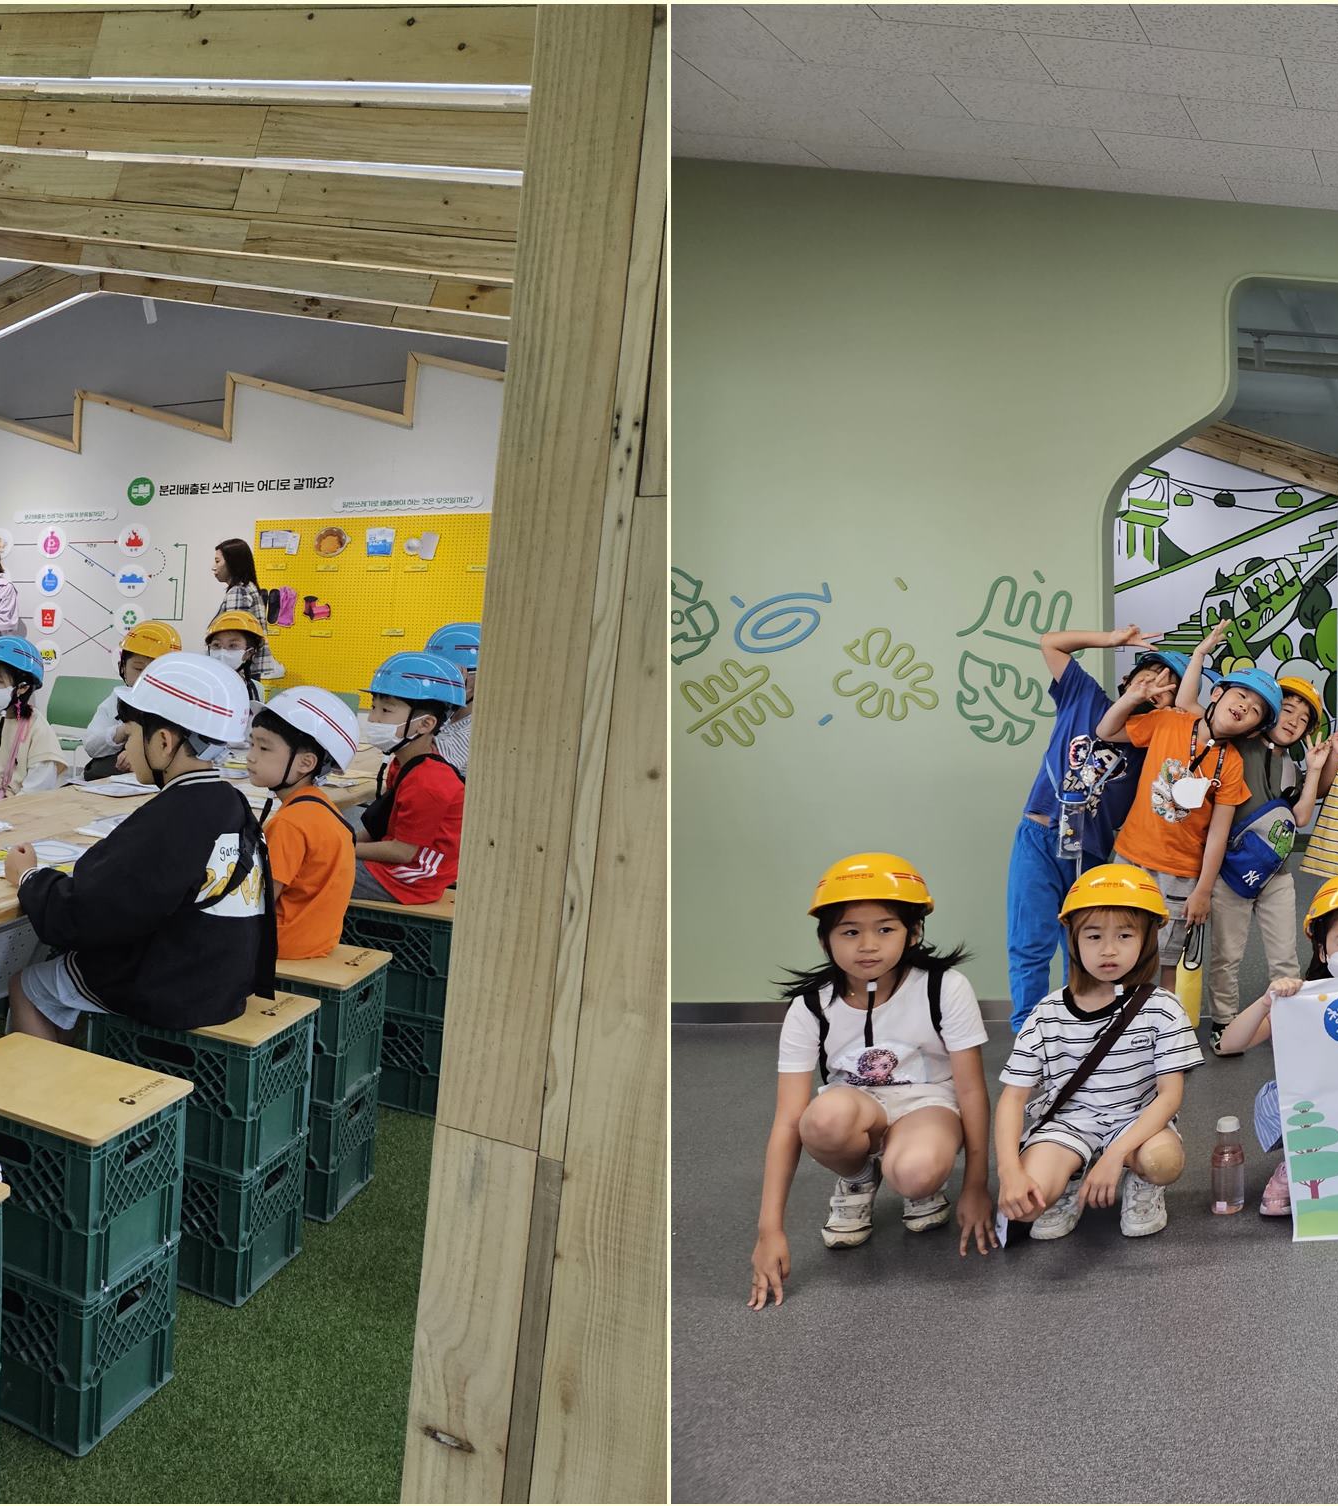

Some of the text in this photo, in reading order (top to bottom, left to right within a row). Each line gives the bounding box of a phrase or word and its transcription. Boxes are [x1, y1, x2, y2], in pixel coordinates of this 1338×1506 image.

[159, 477, 335, 497] 분리배출된 쓰레기는 어디로 갈까요?
